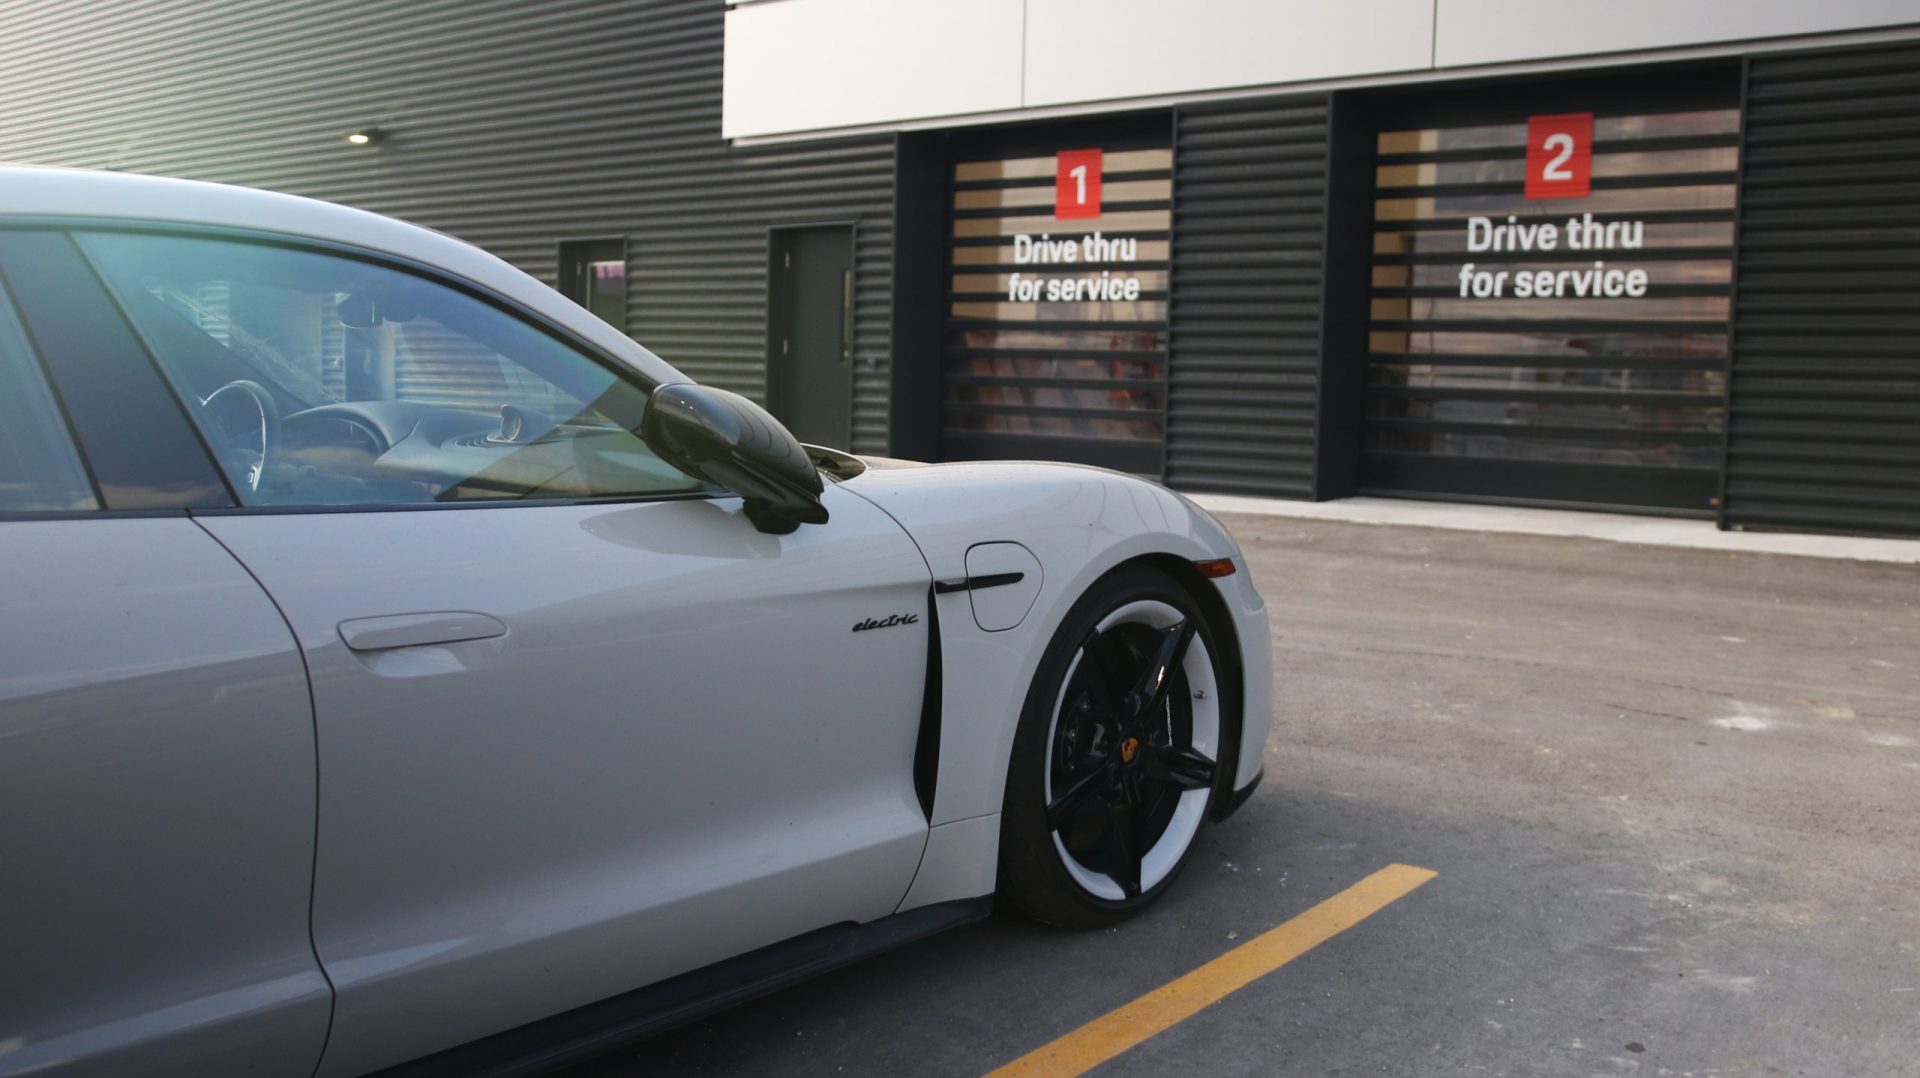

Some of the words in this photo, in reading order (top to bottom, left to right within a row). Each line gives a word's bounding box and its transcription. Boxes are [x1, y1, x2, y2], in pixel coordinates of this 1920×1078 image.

[1542, 133, 1574, 181] 2
[1069, 165, 1087, 205] 1
[1014, 233, 1078, 264] Drive
[1082, 231, 1137, 262] thru
[1467, 215, 1558, 252] Drive
[1566, 213, 1644, 250] thru
[1008, 272, 1044, 301] for
[1047, 271, 1141, 301] service
[1458, 263, 1508, 298] for
[1514, 260, 1648, 297] service
[852, 613, 919, 632] electric
